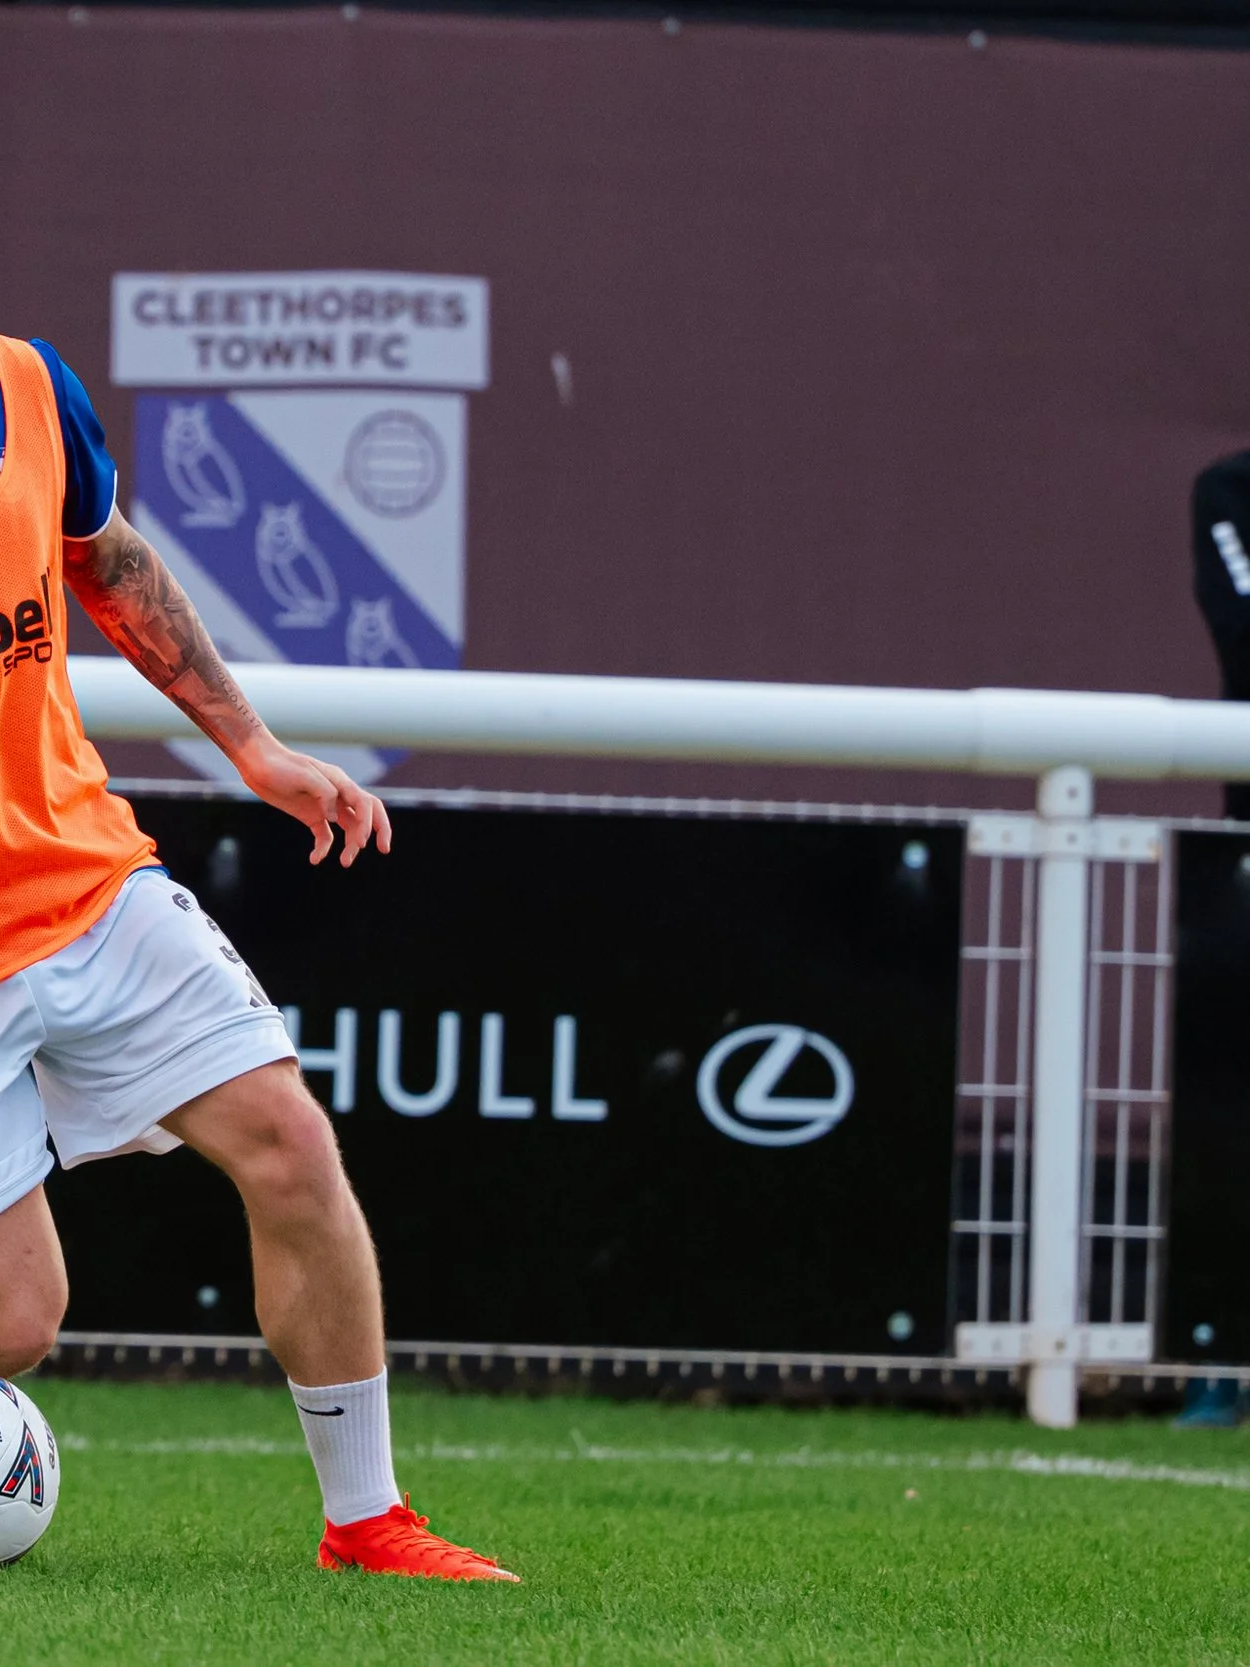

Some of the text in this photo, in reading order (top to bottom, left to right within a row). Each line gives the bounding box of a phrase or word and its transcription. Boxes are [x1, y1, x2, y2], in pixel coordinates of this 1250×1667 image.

[133, 287, 467, 328] CLEETHORPES
[194, 333, 409, 370] TOWN FC
